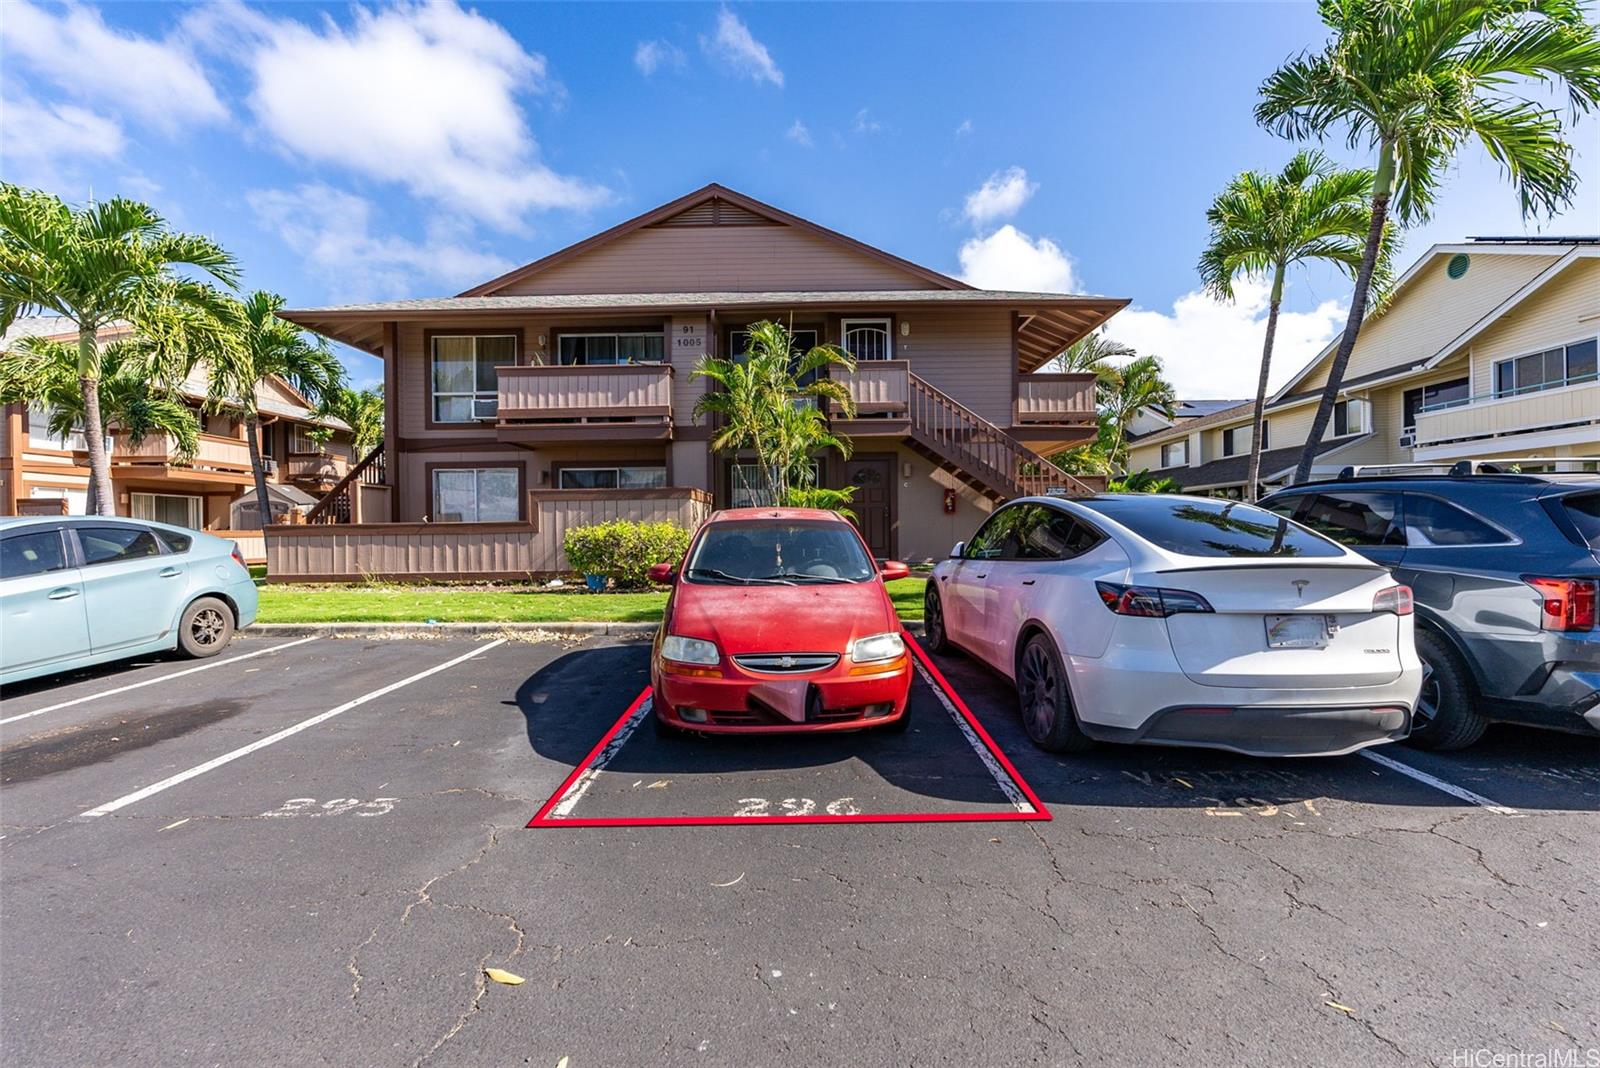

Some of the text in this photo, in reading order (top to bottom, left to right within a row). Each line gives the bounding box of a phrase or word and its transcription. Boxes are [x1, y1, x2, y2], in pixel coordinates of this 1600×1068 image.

[682, 326, 694, 334] 91
[678, 338, 701, 346] 1005
[733, 797, 861, 817] 296
